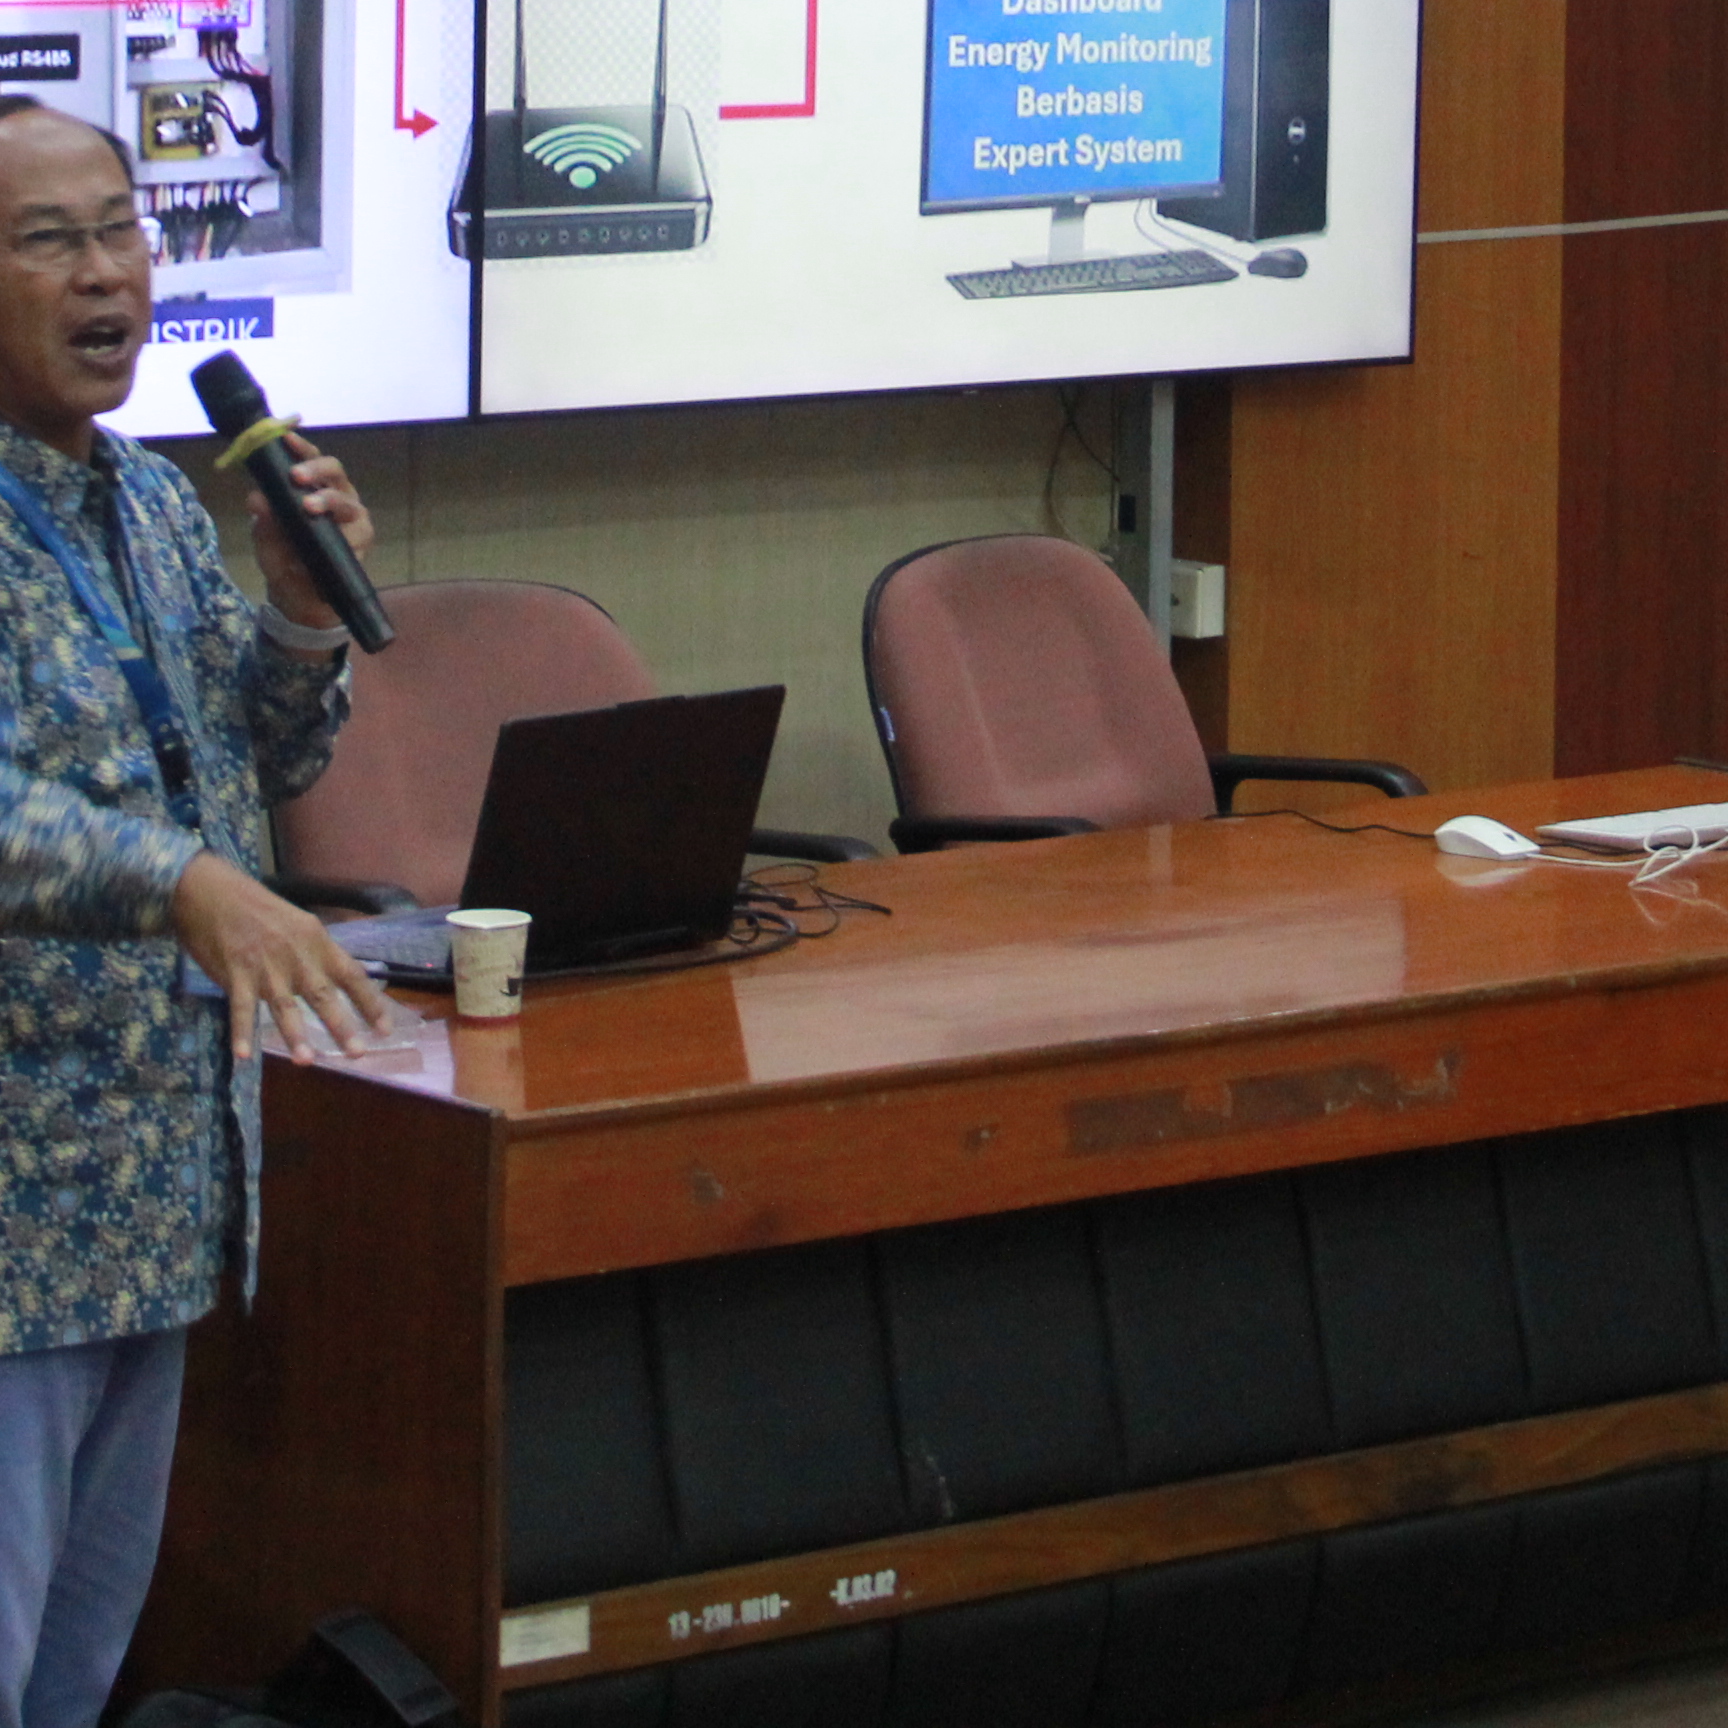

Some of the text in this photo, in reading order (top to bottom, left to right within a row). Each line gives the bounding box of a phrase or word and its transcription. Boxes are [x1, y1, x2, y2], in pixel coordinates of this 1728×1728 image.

[948, 31, 1212, 73] Energy Monitoring
[1016, 83, 1144, 118] Berbasis
[974, 134, 1183, 175] Expert System
[151, 317, 259, 343] ISTRIK
